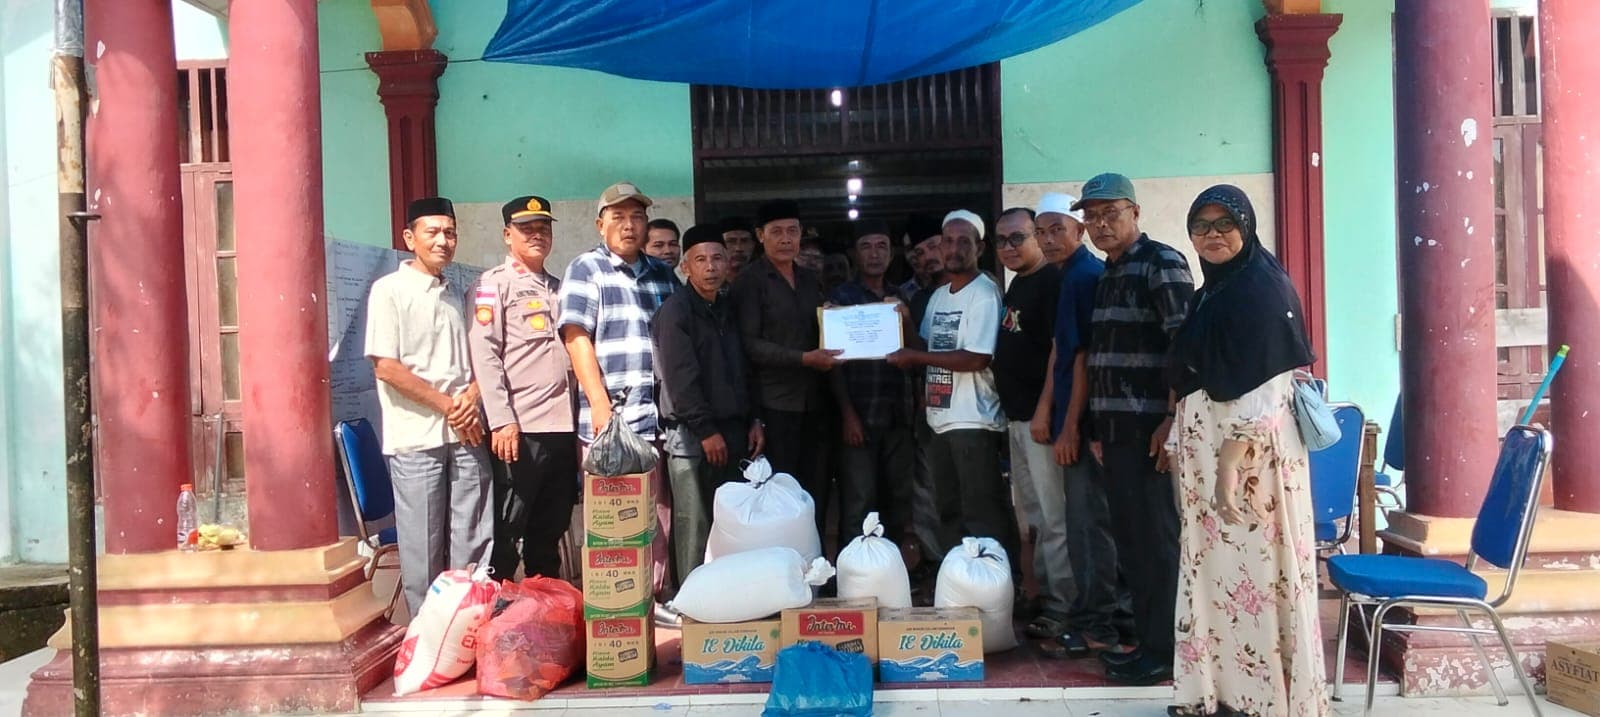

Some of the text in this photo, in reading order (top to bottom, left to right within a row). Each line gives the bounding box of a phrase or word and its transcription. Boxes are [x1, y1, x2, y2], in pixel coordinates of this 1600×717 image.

[609, 498, 622, 506] 40
[605, 569, 619, 578] 40
[609, 640, 622, 648] 40
[723, 634, 765, 654] Dikila
[920, 631, 963, 651] Dikila
[1551, 659, 1599, 682] ASYFIAT
